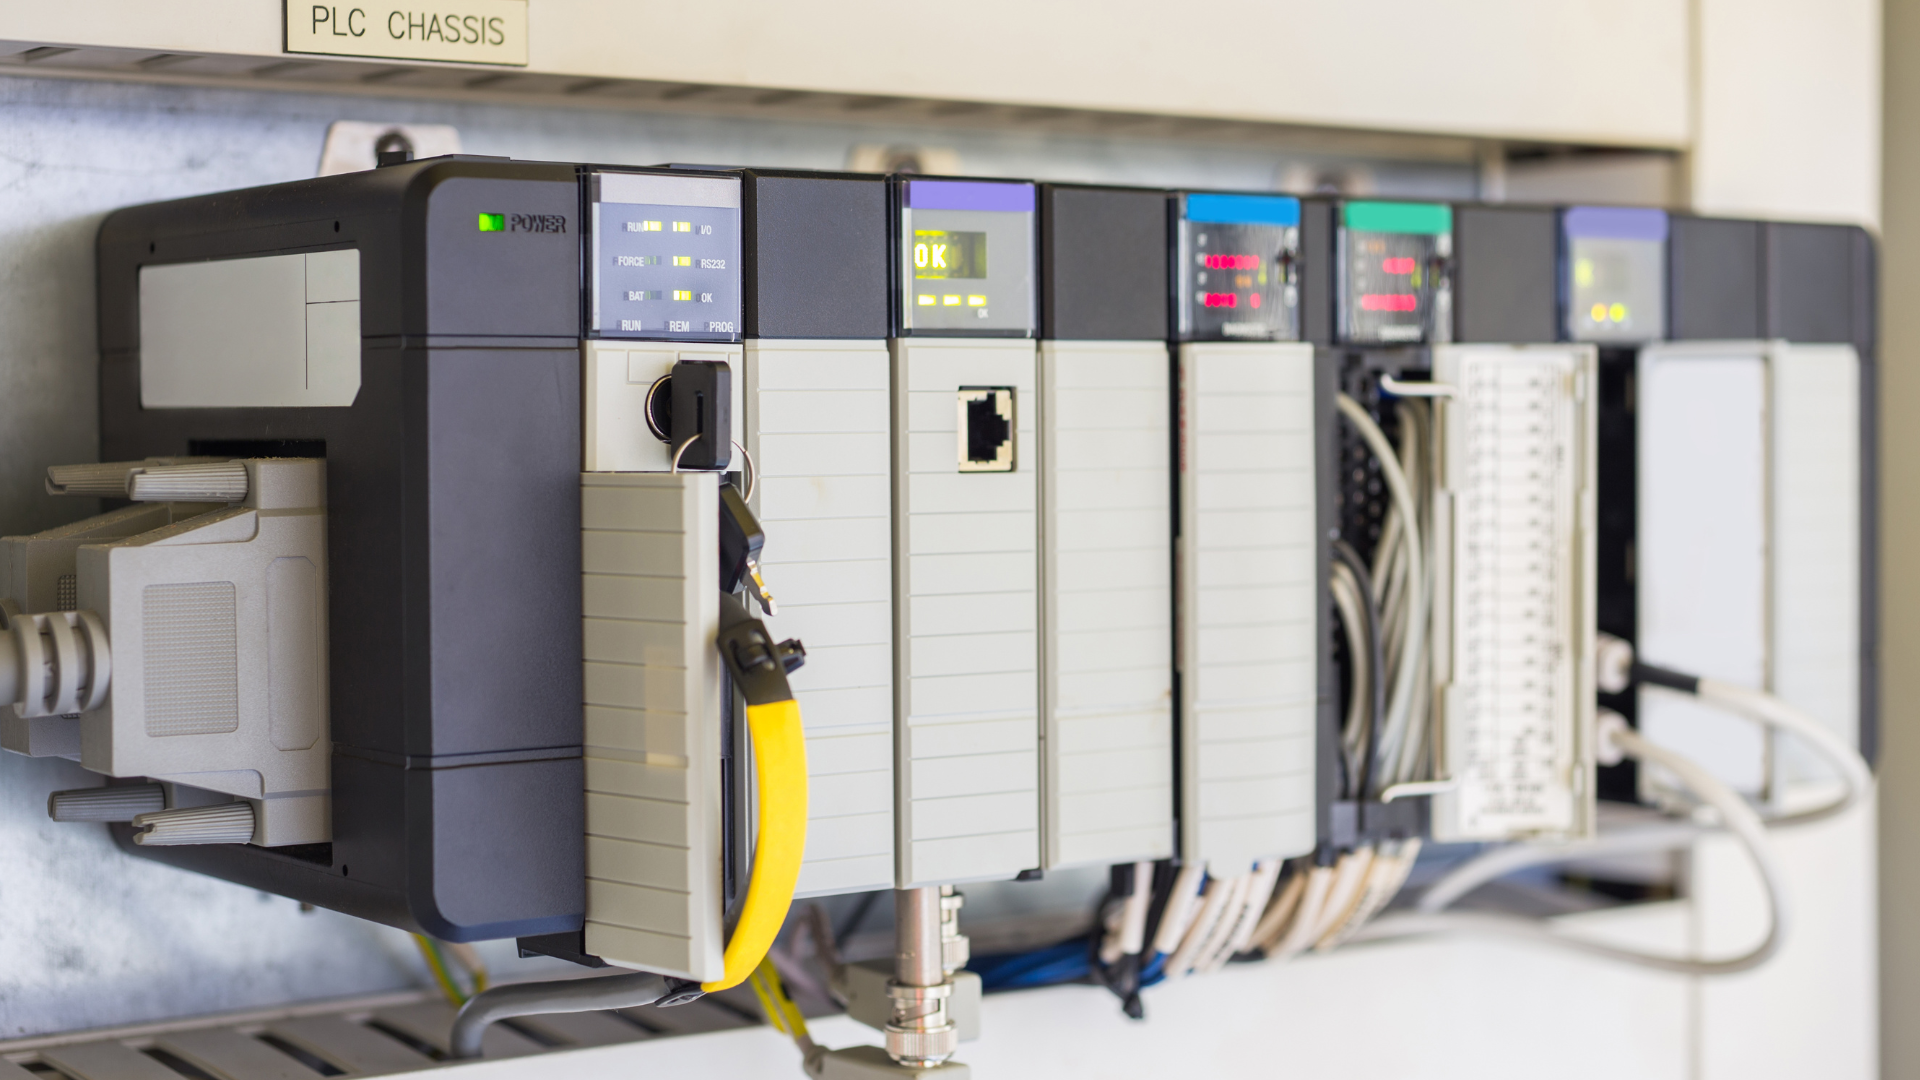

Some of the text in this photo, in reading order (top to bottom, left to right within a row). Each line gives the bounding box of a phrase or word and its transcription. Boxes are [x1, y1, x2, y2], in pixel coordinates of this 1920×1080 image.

[312, 5, 505, 46] PLC CHASSIS
[511, 213, 566, 233] POWER
[627, 222, 644, 233] RUN
[700, 225, 712, 235] I/O
[618, 256, 645, 267] FORCE
[914, 243, 947, 269] OK
[701, 259, 726, 270] RS232
[628, 291, 645, 301] BAT
[701, 292, 713, 303] OK
[621, 320, 734, 333] RUN REM PROG
